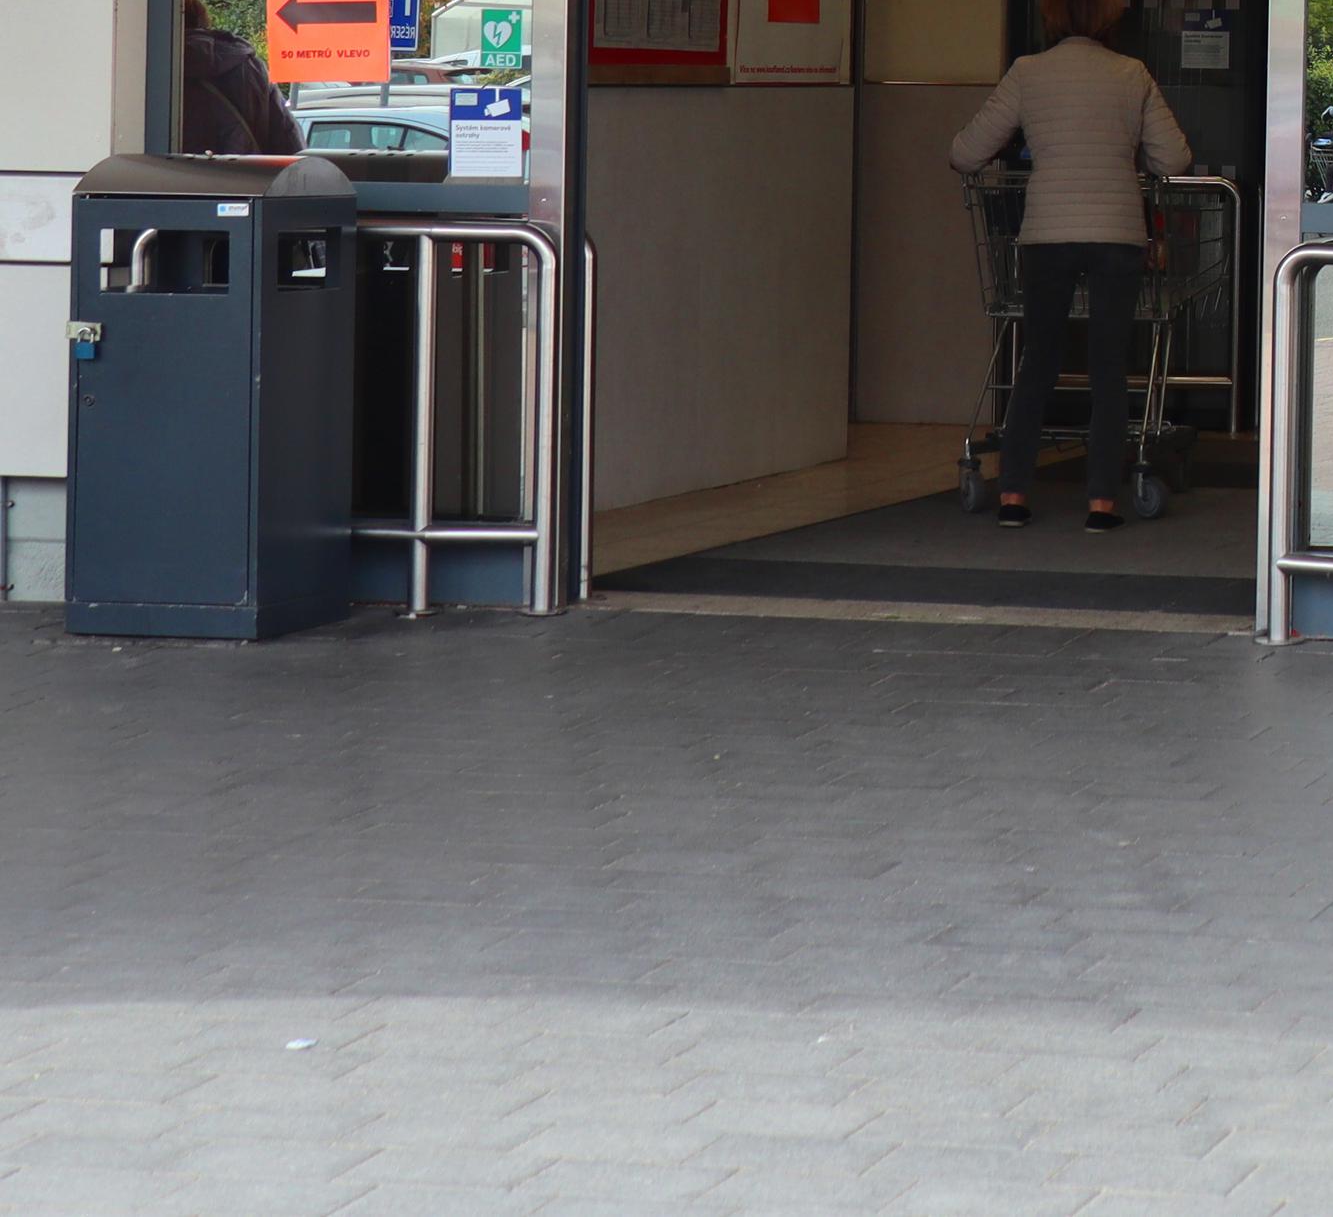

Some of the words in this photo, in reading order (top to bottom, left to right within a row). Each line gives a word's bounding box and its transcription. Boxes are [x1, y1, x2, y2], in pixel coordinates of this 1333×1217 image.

[281, 50, 294, 59] 50
[296, 47, 332, 58] METRŮ
[337, 49, 371, 58] VLEVO
[485, 56, 516, 68] AED
